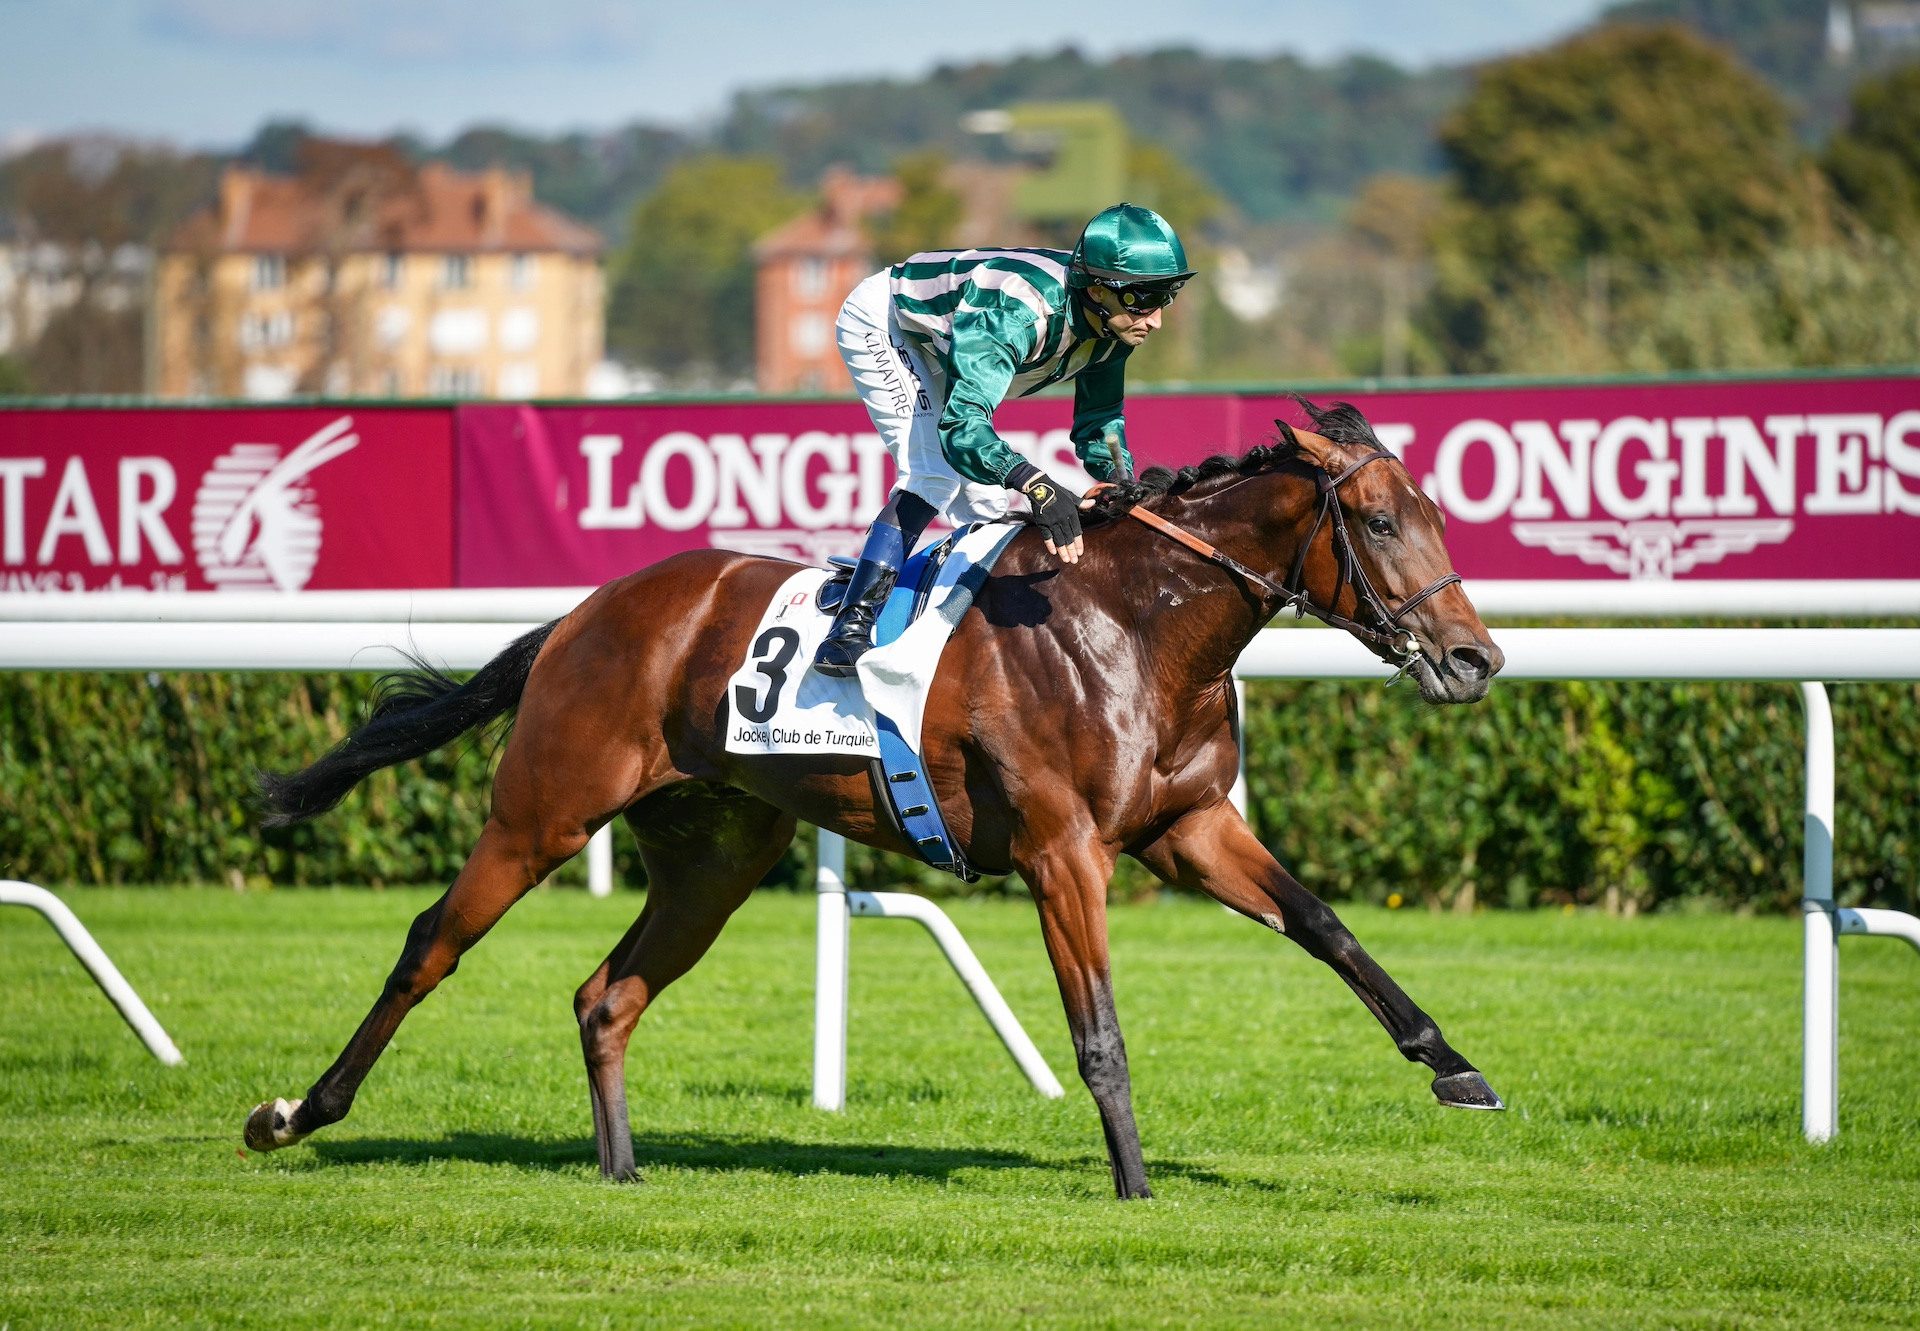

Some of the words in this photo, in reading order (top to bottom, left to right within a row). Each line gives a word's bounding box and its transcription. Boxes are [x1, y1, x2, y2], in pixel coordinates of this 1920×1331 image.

[735, 626, 800, 723] 3
[772, 728, 801, 744] Club
[804, 730, 822, 744] de
[825, 730, 874, 747] Turquie
